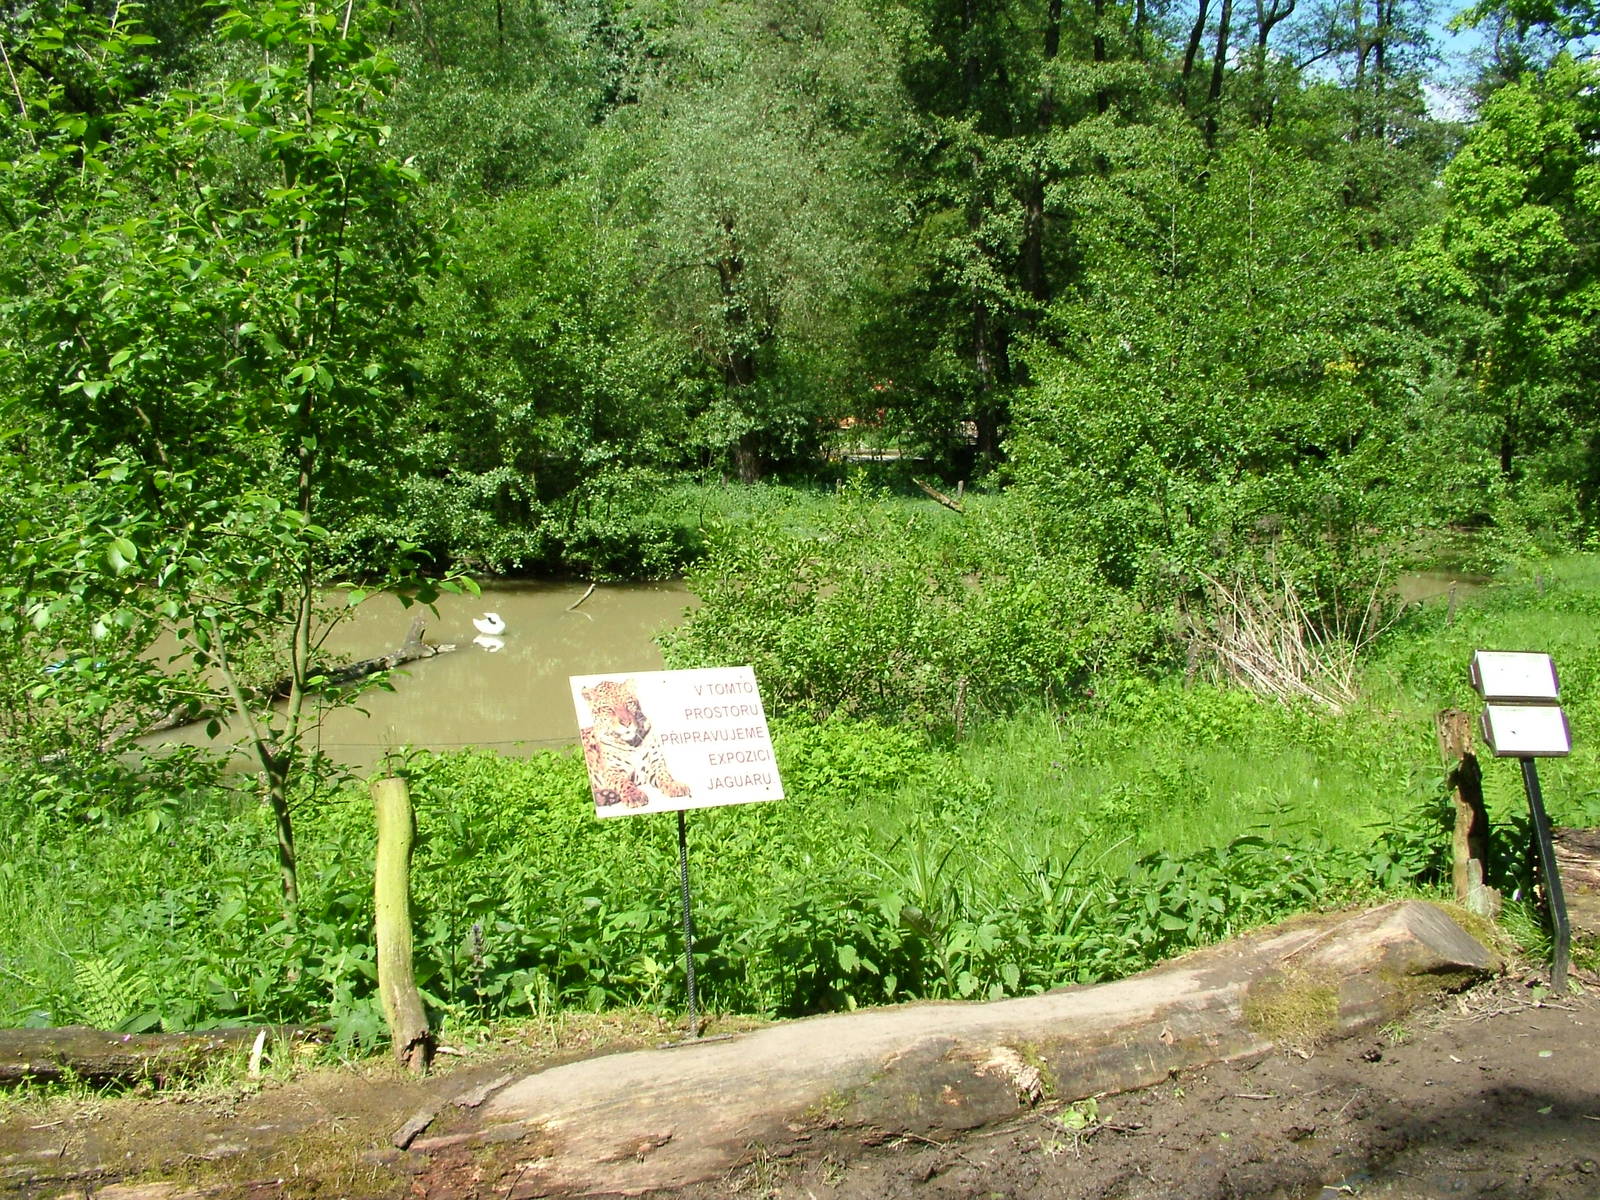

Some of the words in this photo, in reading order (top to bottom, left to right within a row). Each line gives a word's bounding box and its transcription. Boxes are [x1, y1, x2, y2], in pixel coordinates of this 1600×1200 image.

[694, 684, 704, 697] V
[706, 682, 754, 696] TOMTO
[684, 704, 759, 720] PROSTORU
[708, 749, 770, 766] EXPOZICI
